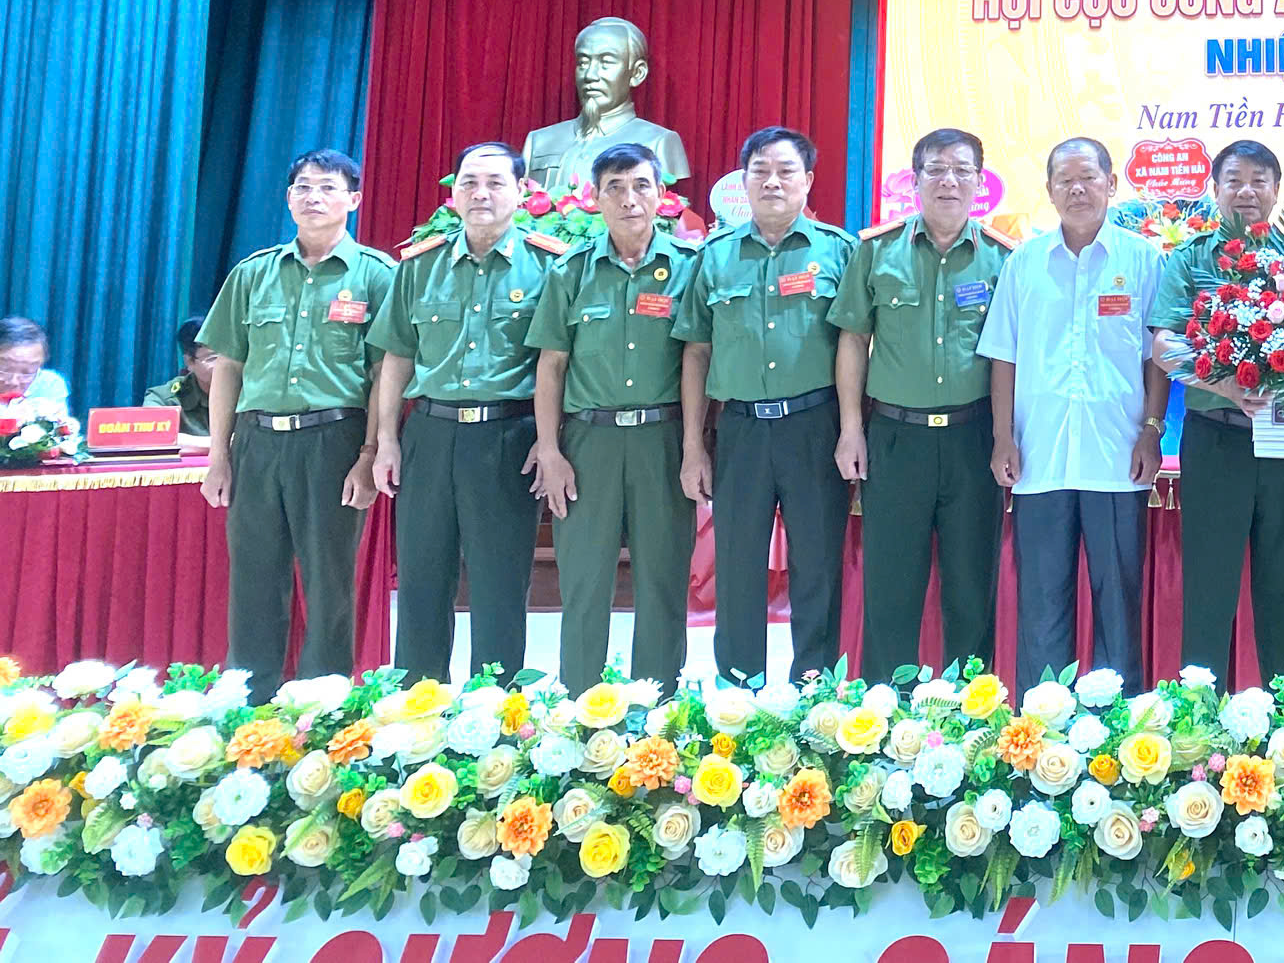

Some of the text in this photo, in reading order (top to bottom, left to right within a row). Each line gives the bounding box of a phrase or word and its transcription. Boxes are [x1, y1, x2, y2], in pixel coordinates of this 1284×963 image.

[1137, 104, 1198, 130] Nam
[1209, 97, 1266, 129] Tiền
[1176, 152, 1189, 162] AN
[1148, 166, 1169, 176] NAM
